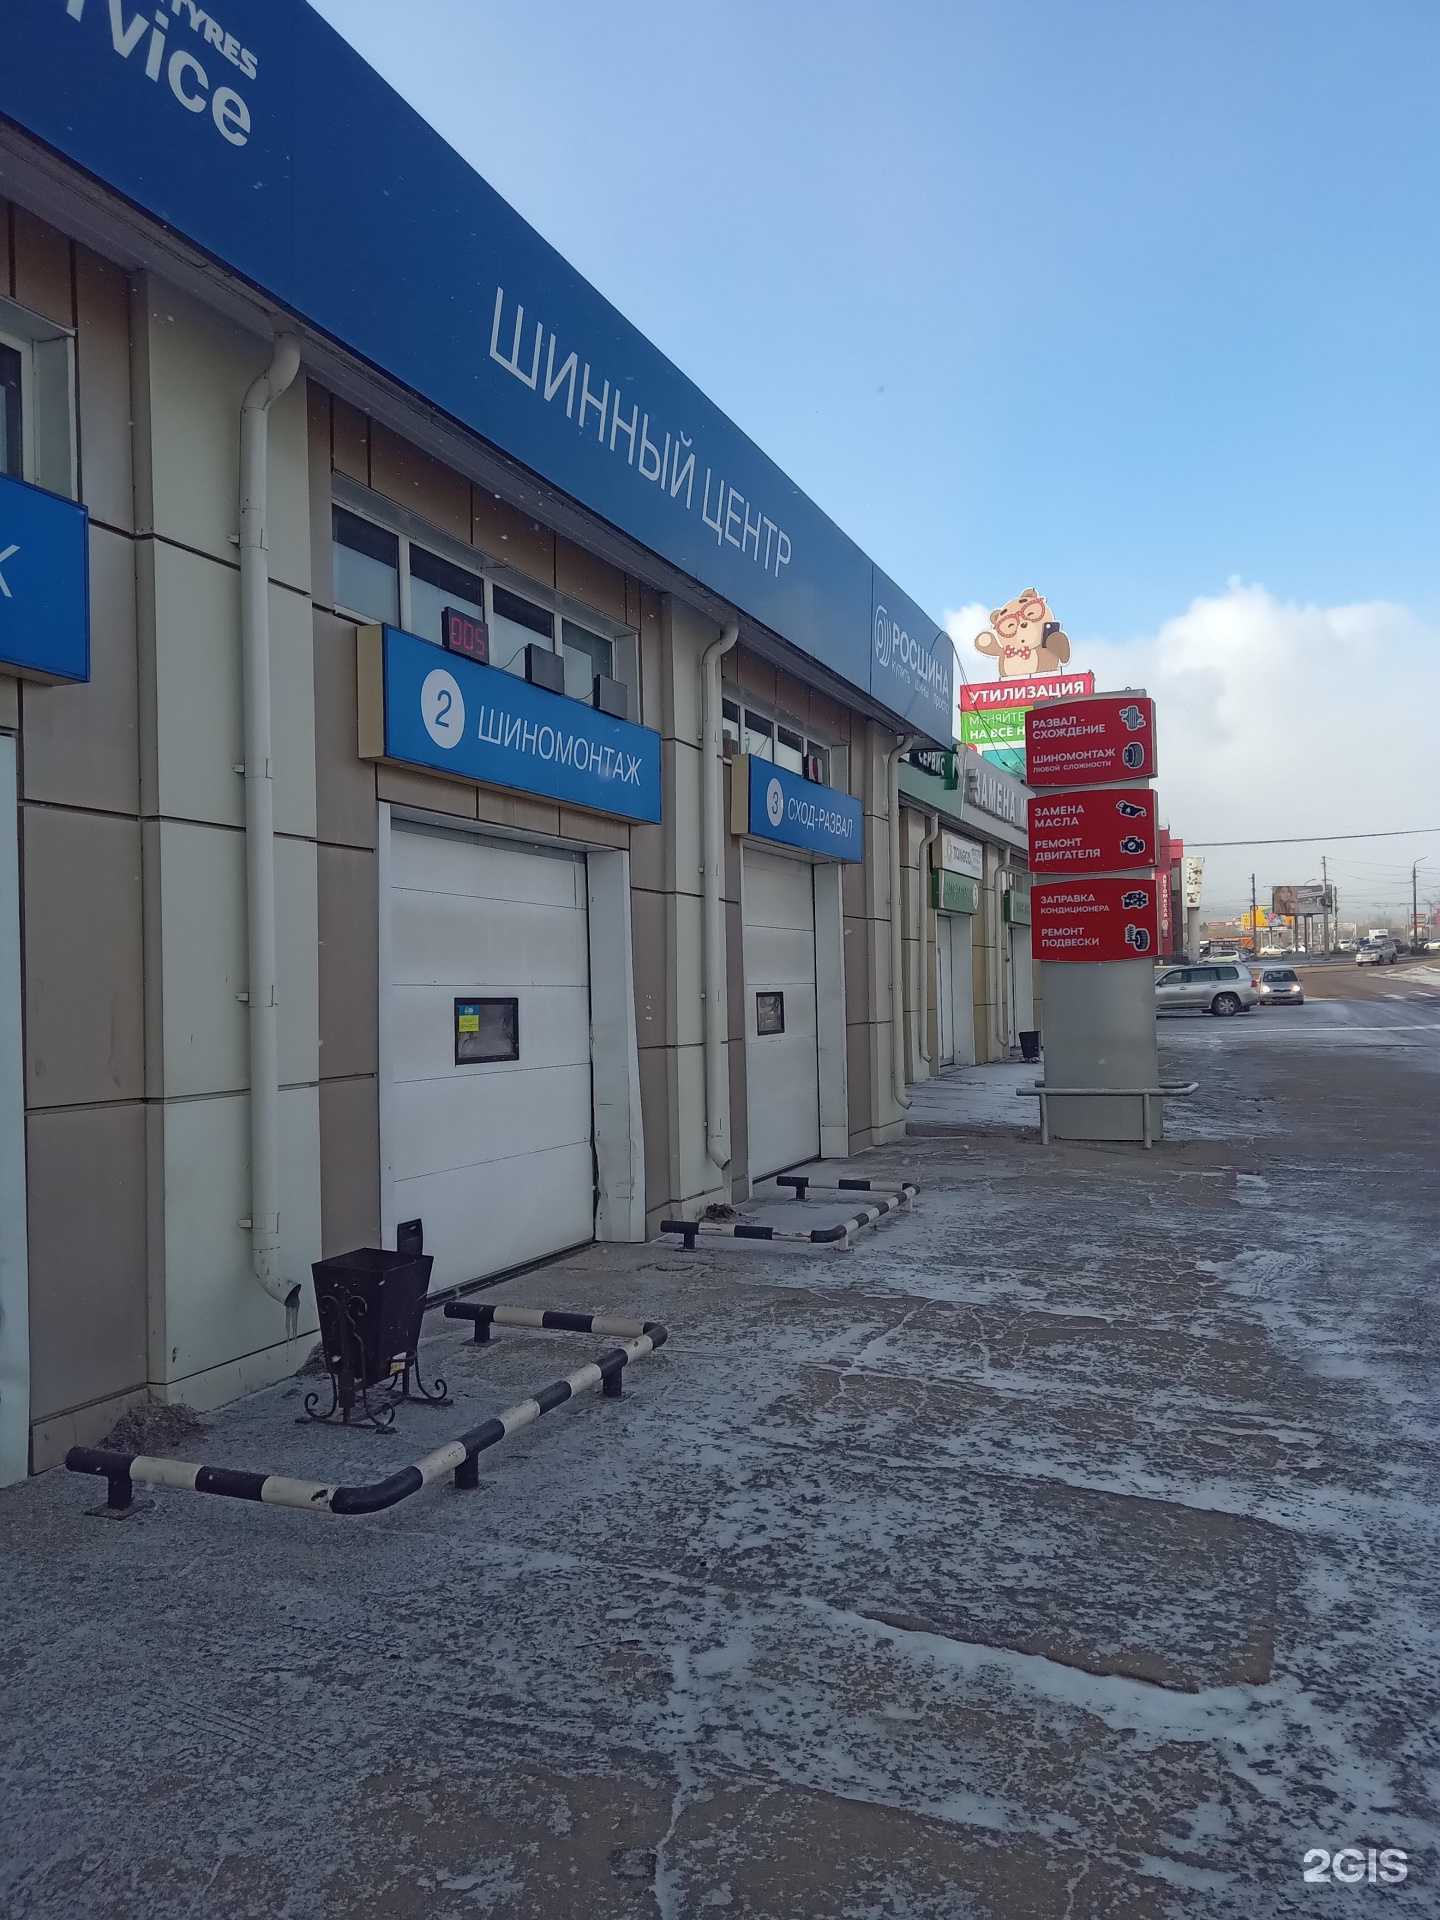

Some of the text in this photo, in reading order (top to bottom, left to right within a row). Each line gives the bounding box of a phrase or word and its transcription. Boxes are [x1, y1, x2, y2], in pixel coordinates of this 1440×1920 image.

[489, 286, 791, 577] ШИННЫЙ ЦЕНТР
[893, 621, 950, 701] РОСШИНА
[968, 681, 1084, 704] УТИЛИЗАЦИЯ
[1032, 716, 1077, 729] РАЗВАЛ
[435, 690, 643, 786] 2 ШИНОМОНТАЖ
[970, 729, 987, 740] НА
[1032, 723, 1106, 740] СХОЖДЕНИЕ
[1032, 748, 1116, 764] ШИНОМОНТАЖ
[974, 767, 1016, 822] ЗАМЕНА
[771, 791, 853, 840] 3 СХОД-РАЗВАЛ
[1034, 805, 1085, 817] ЗАМЕНА
[1034, 816, 1080, 829] МАСЛА
[1034, 837, 1083, 850] РЕМОНТ
[1034, 849, 1101, 862] ДВИГАТЕЛЯ
[1040, 893, 1096, 904] ЗАПРАВКА
[1040, 904, 1110, 915] КОНДИЦИОНЕРА
[1041, 927, 1085, 937] РЕМОНТ
[1041, 937, 1100, 948] ПОДВЕСКИ
